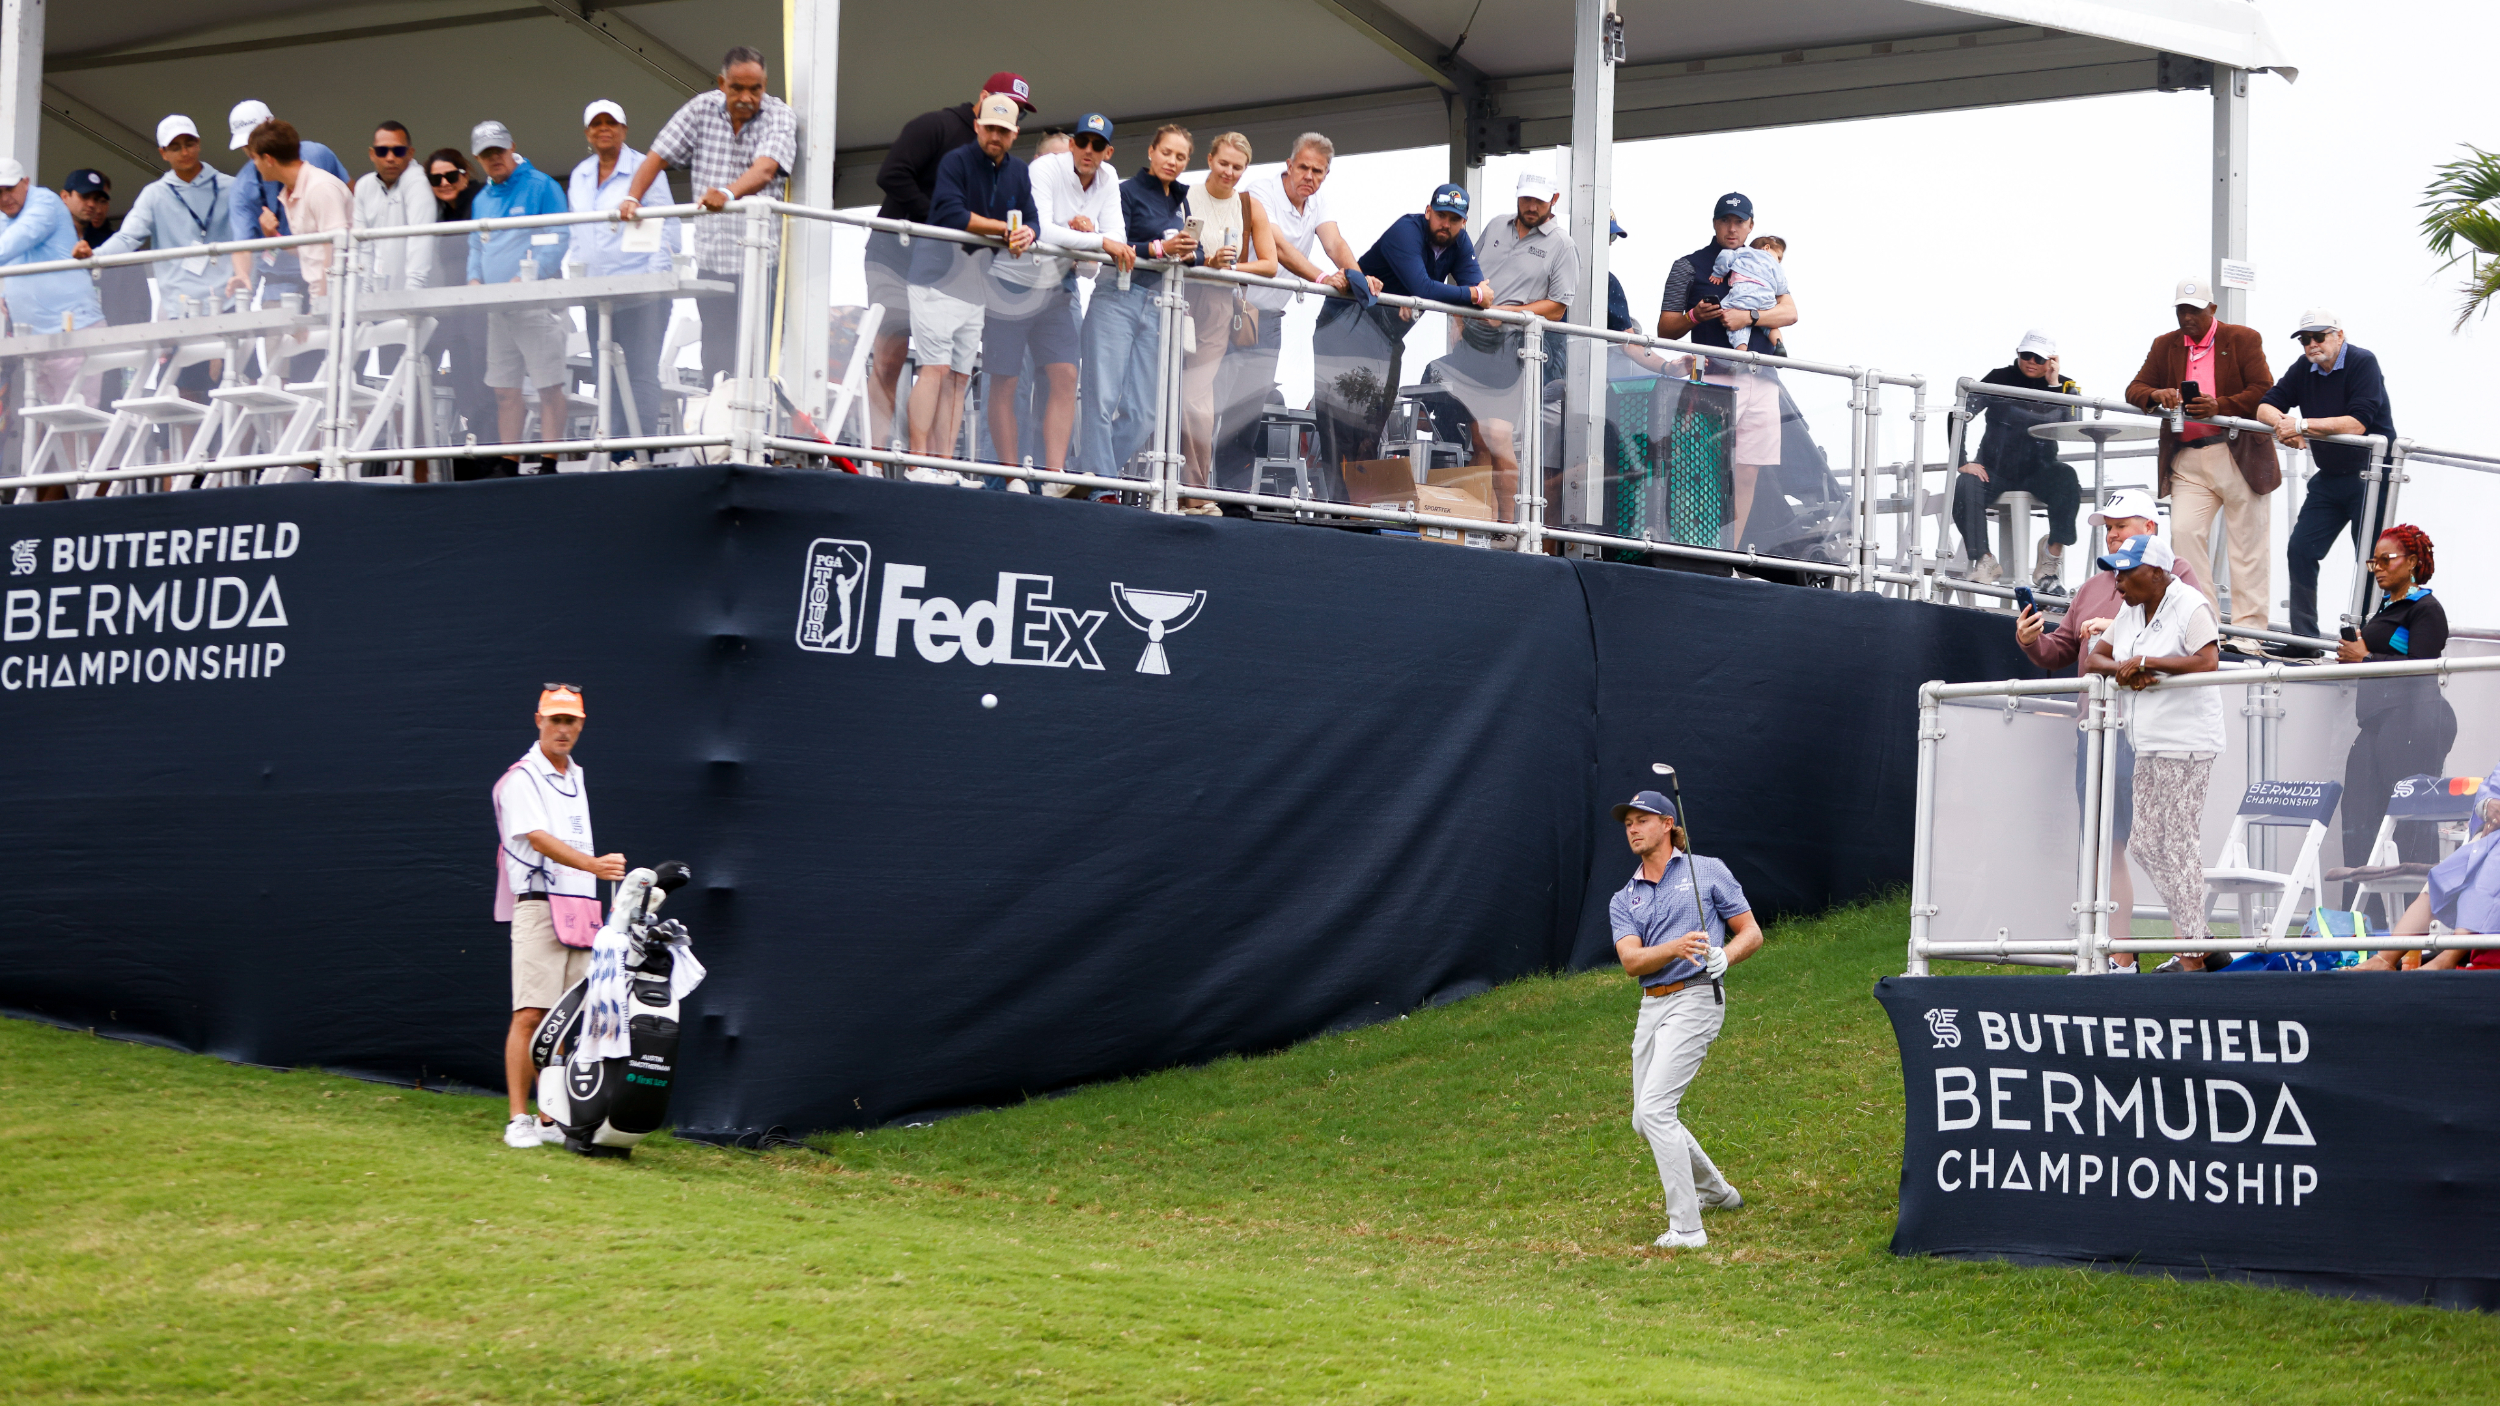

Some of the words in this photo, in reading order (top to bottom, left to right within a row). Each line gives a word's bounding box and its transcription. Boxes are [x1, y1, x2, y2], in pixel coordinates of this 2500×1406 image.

[53, 522, 300, 573] BUTTERFIELD
[815, 554, 843, 568] PGA
[4, 575, 288, 642] BERMUDA
[803, 566, 833, 643] TOUR
[875, 563, 1110, 671] FedEx
[0, 643, 286, 691] CHAMPIONSHIP
[2245, 795, 2319, 807] CHAMPIONSHIP
[2249, 783, 2321, 797] BERMUDA
[541, 1008, 567, 1044] GOLF
[1978, 1010, 2310, 1064] BUTTERFIELD
[1935, 1066, 2317, 1146] BERMUDA
[1937, 1149, 2319, 1207] CHAMPIONSHIP
